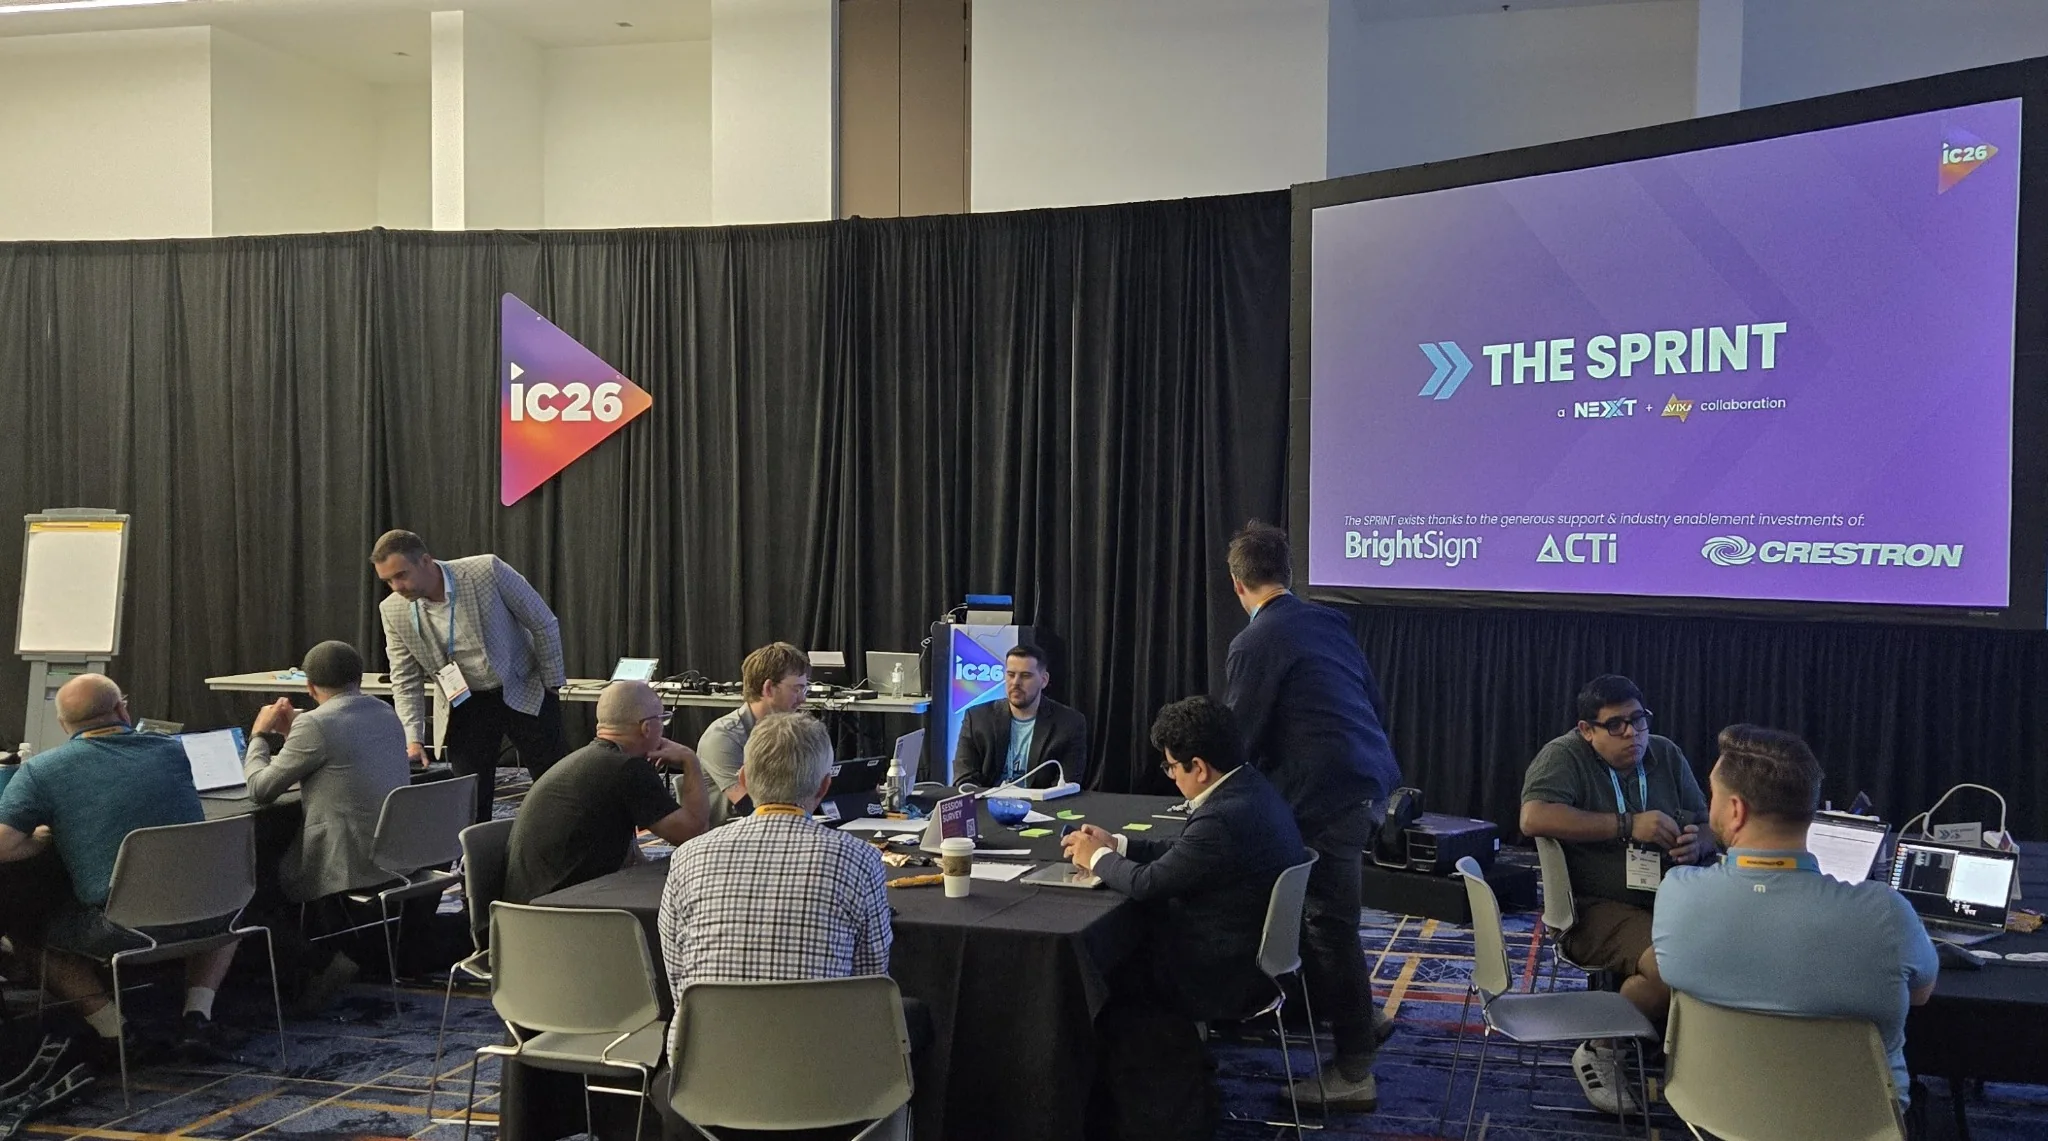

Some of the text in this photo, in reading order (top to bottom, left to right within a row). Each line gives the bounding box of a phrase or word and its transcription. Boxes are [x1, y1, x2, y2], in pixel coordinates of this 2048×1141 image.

[1482, 321, 1787, 386] THE SPRINT
[1557, 409, 1566, 418] a
[1700, 397, 1786, 412] collaboration
[1344, 512, 1865, 528] The SPRINT exists thanks to the generous support & industry enablement investments of:
[1758, 541, 1964, 567] CRESTRON
[941, 799, 963, 813] SESSION
[942, 810, 963, 823] SURVEY
